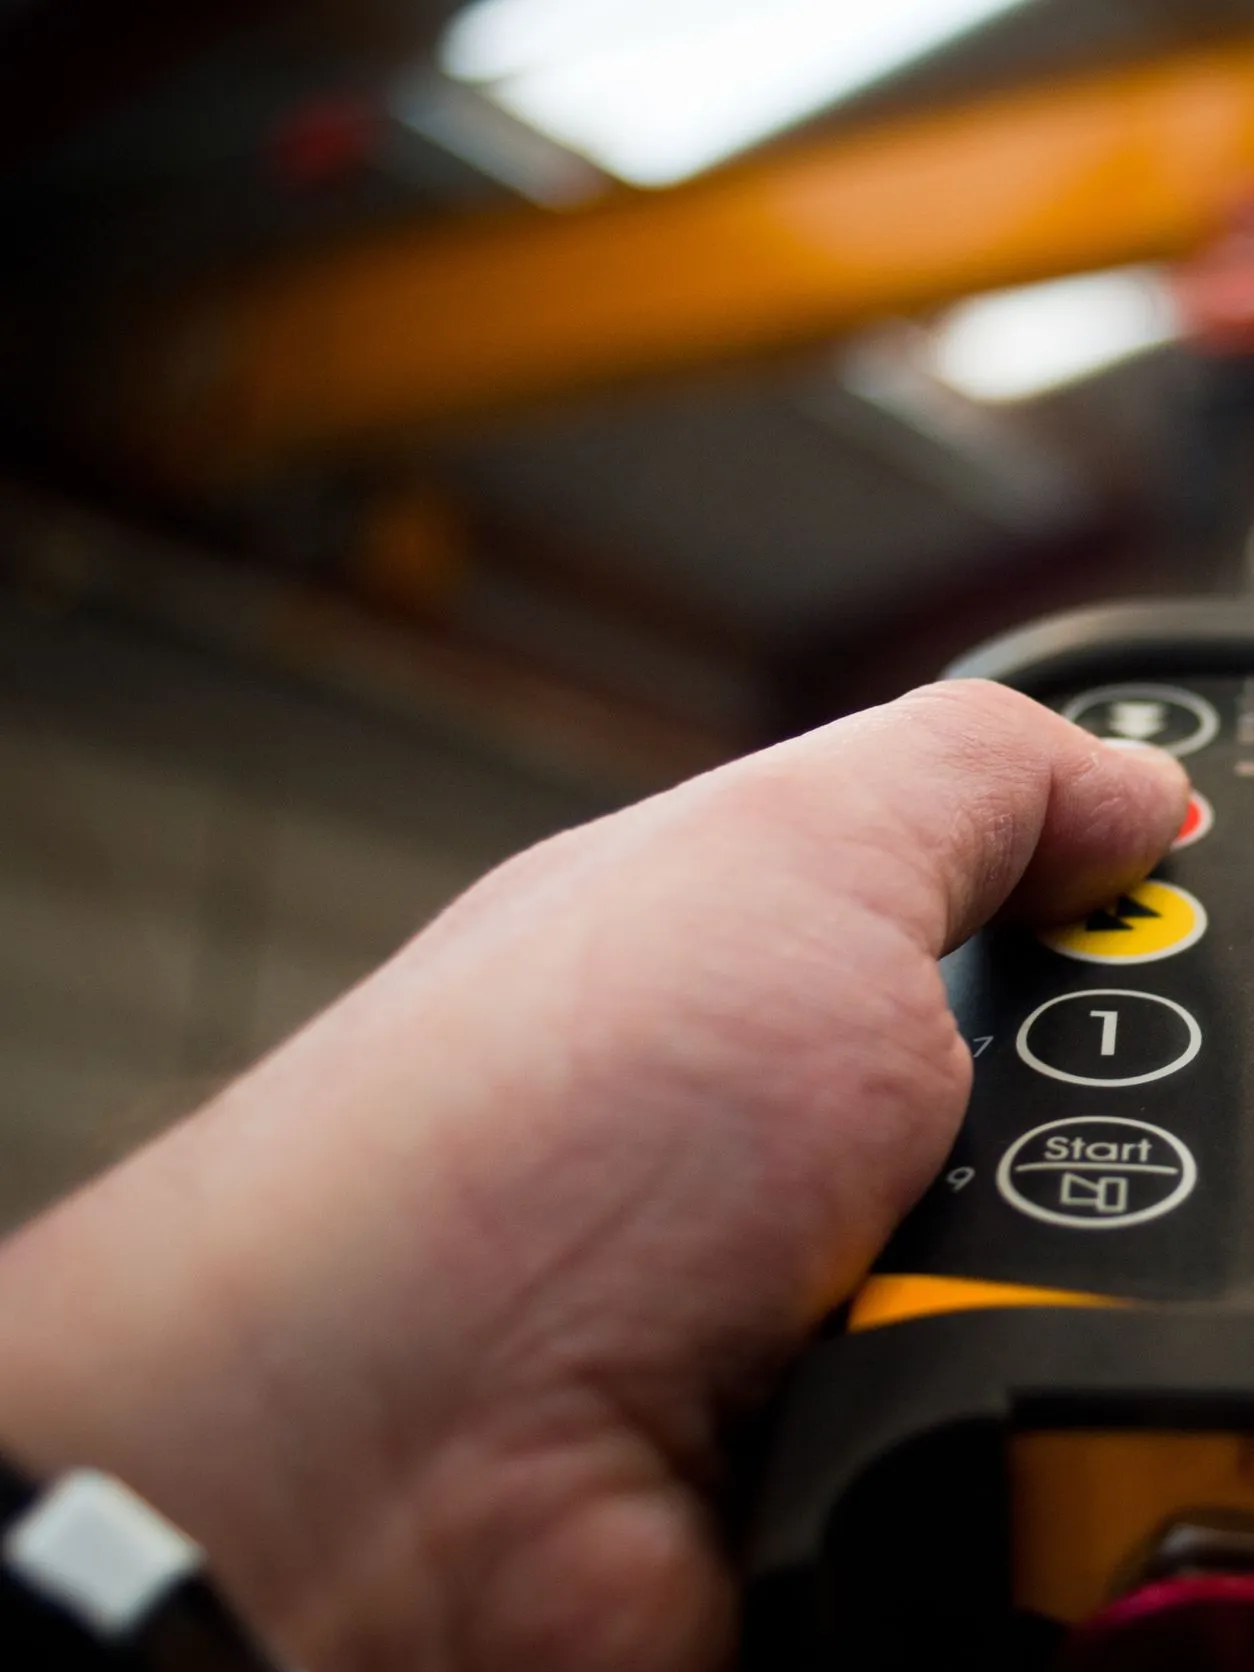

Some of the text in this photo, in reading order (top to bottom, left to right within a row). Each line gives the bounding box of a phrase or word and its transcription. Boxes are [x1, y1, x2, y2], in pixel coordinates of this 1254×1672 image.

[973, 1035, 994, 1058] 7
[1090, 1010, 1118, 1056] 1
[1044, 1135, 1152, 1163] Start
[946, 1166, 976, 1193] 9
